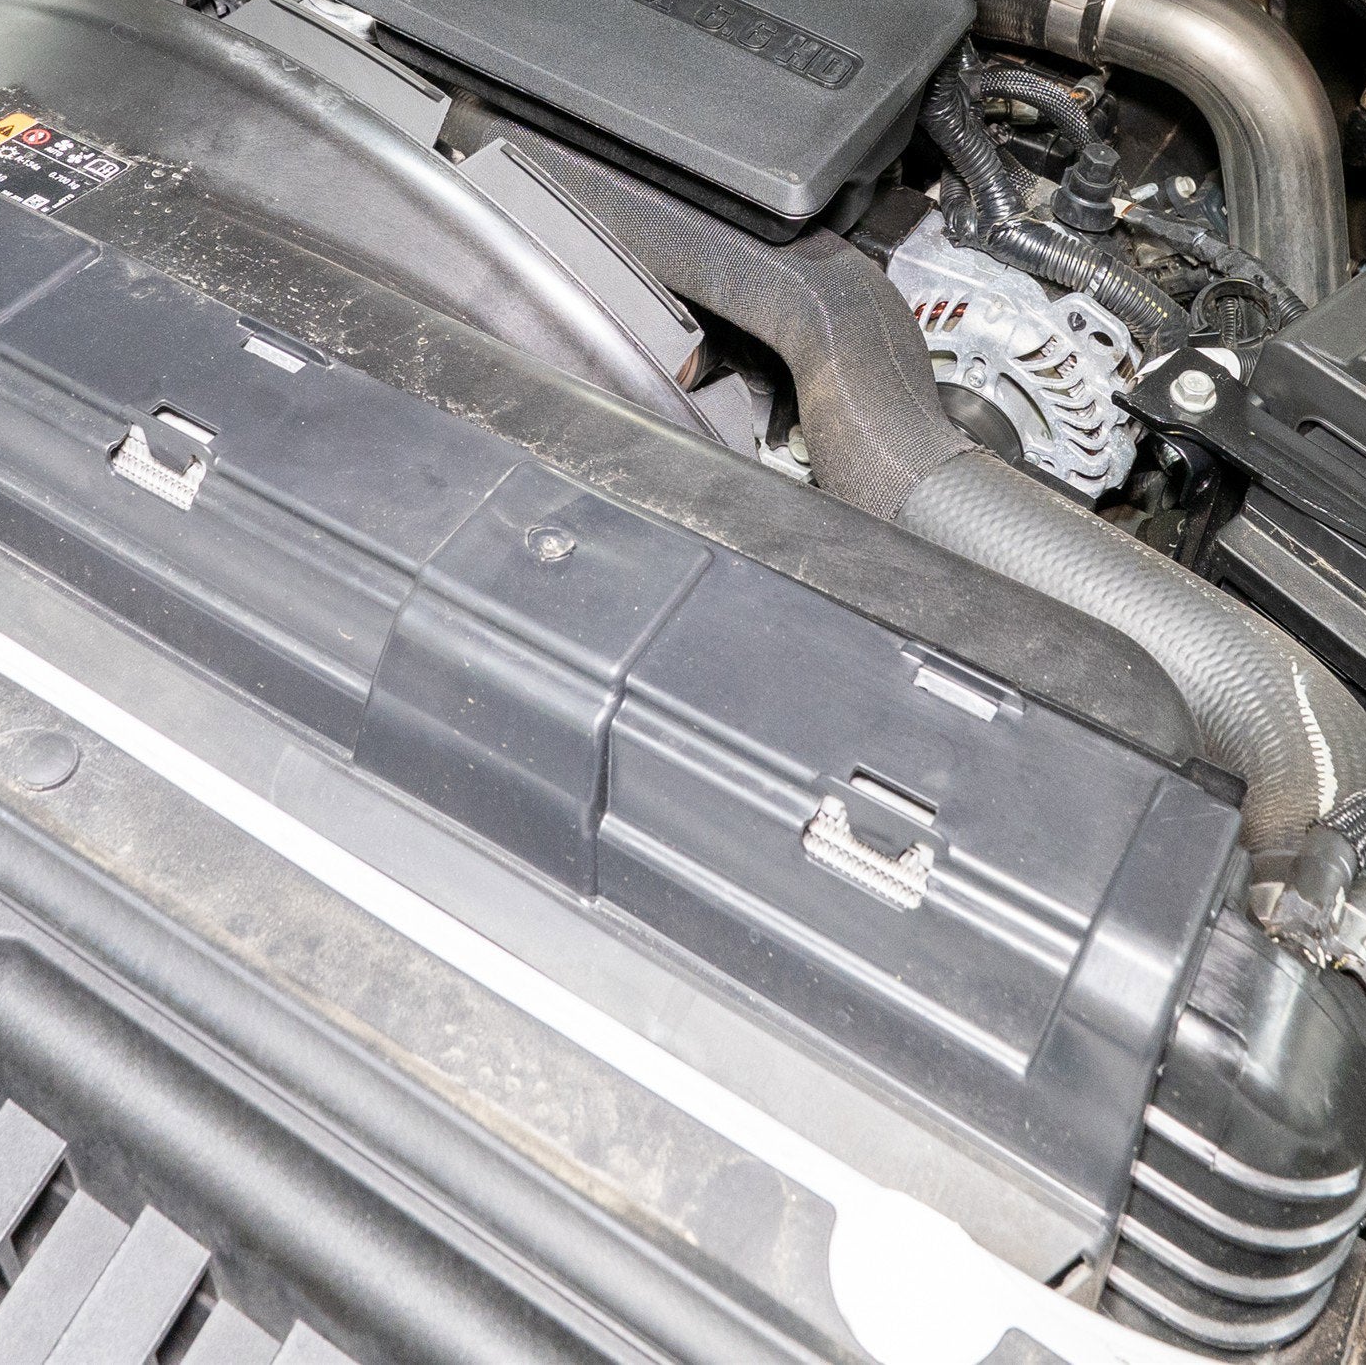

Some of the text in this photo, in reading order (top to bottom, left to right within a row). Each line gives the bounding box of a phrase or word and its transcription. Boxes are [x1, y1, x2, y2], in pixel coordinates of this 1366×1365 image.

[693, 1, 779, 52] 6.6
[775, 34, 854, 86] HD
[44, 146, 64, 157] AUTO
